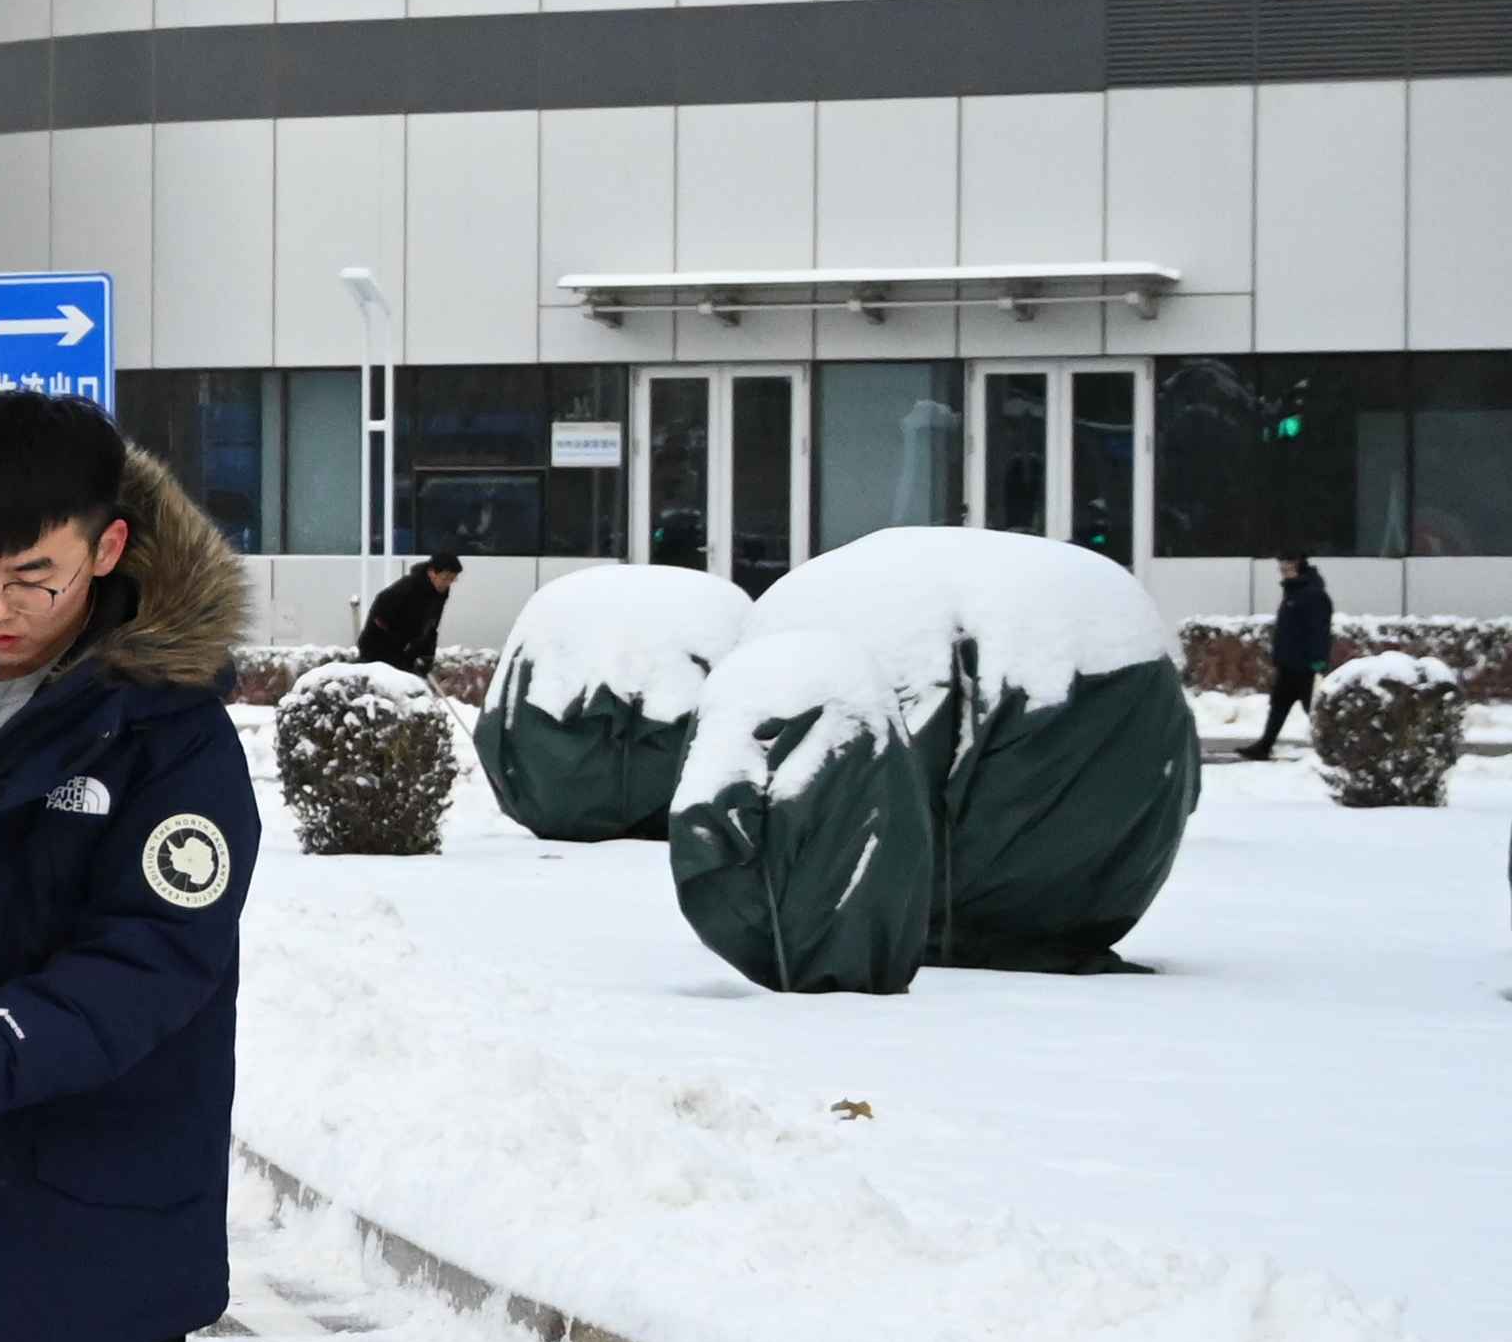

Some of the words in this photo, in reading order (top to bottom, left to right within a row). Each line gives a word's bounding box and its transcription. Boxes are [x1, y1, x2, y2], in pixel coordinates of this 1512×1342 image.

[66, 775, 87, 788] HE
[46, 786, 86, 801] RTH
[46, 798, 84, 812] FACE
[175, 818, 209, 831] NORTH
